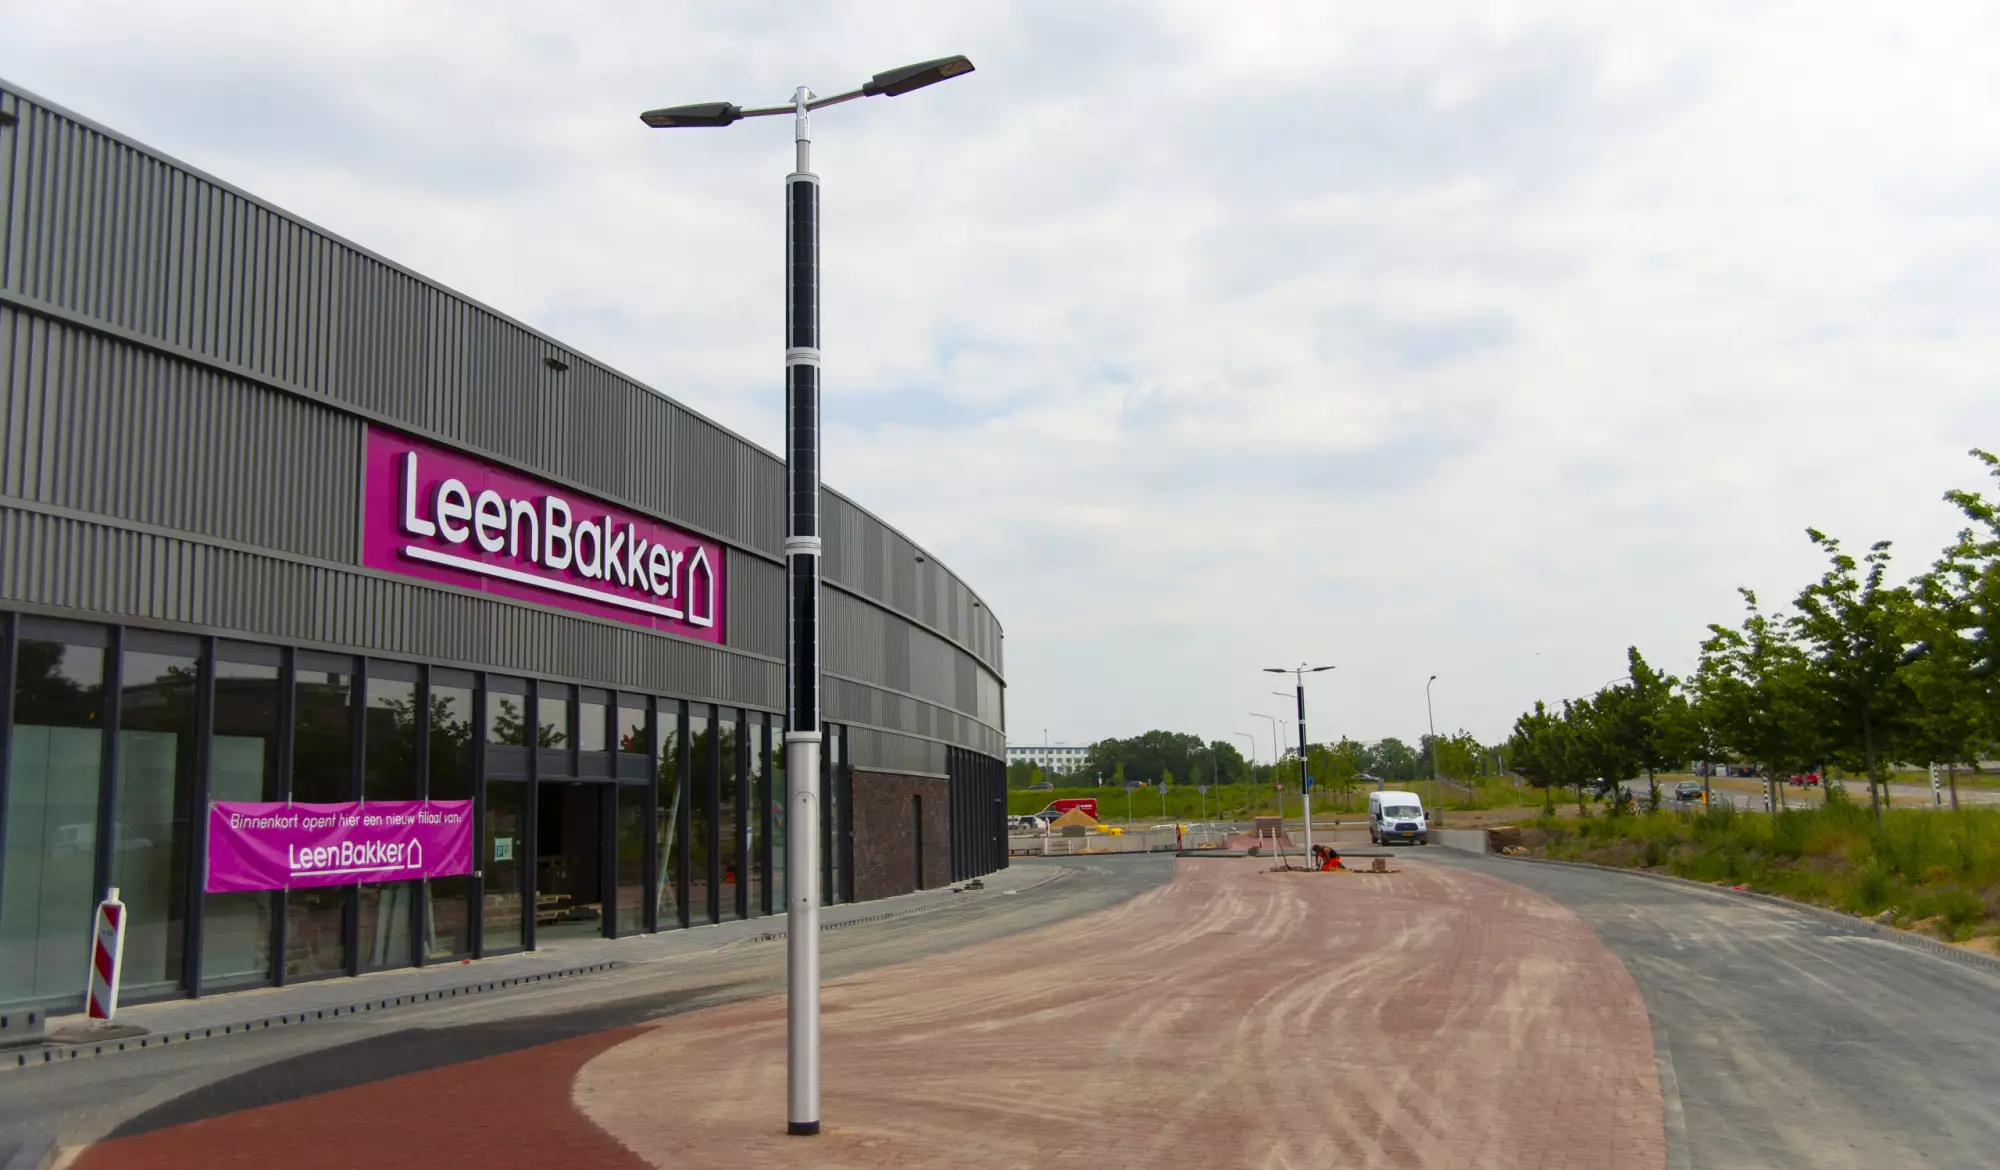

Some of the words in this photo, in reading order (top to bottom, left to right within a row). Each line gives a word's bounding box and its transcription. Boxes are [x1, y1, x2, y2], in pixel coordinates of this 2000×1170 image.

[405, 451, 684, 599] LeenBakker
[231, 813, 299, 829] Binnenkort
[302, 813, 336, 832] opent
[338, 813, 360, 827] hier
[363, 814, 383, 826] een
[386, 812, 415, 826] nieuw
[418, 810, 442, 824] filiaal
[289, 840, 405, 869] LeenBakker
